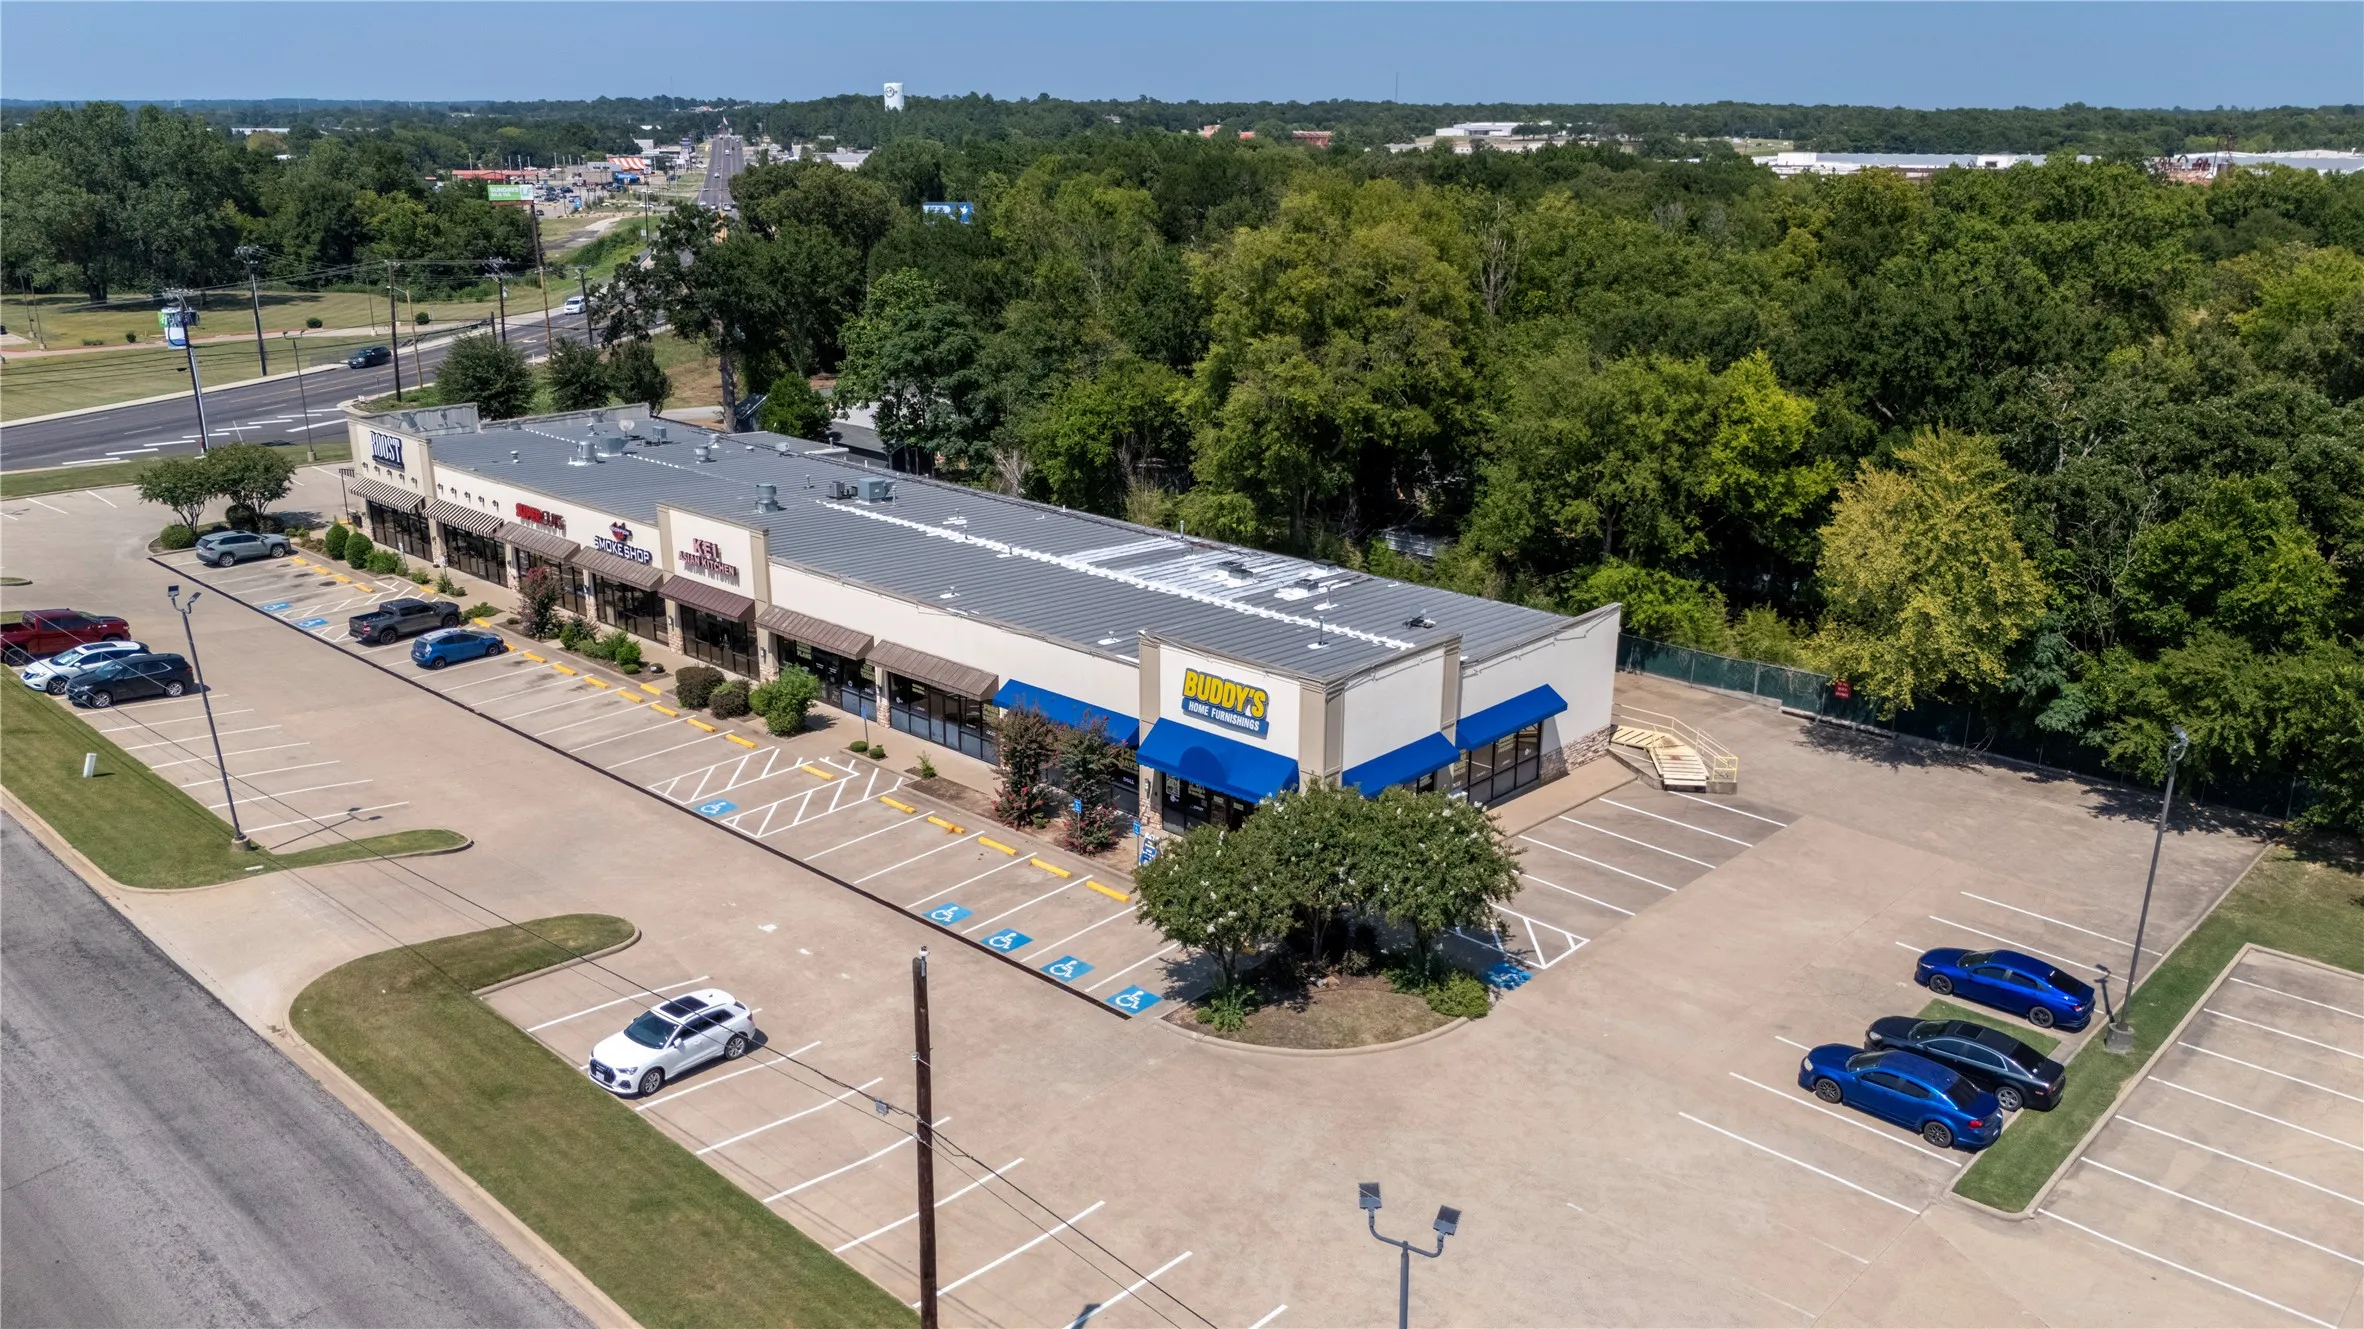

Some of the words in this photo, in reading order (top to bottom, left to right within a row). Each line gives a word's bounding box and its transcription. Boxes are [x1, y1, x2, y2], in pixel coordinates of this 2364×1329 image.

[370, 431, 401, 463] ROOST
[515, 502, 565, 531] SUPERCUTS
[595, 536, 624, 557] SMOKE
[623, 543, 651, 564] SHOP
[693, 538, 719, 559] KEI
[679, 551, 701, 566] ASIAN
[701, 557, 737, 577] KITCHEN
[1183, 670, 1266, 718] BUDDY'S
[1188, 700, 1209, 716] HOME
[1210, 707, 1260, 731] FURNISHINGS
